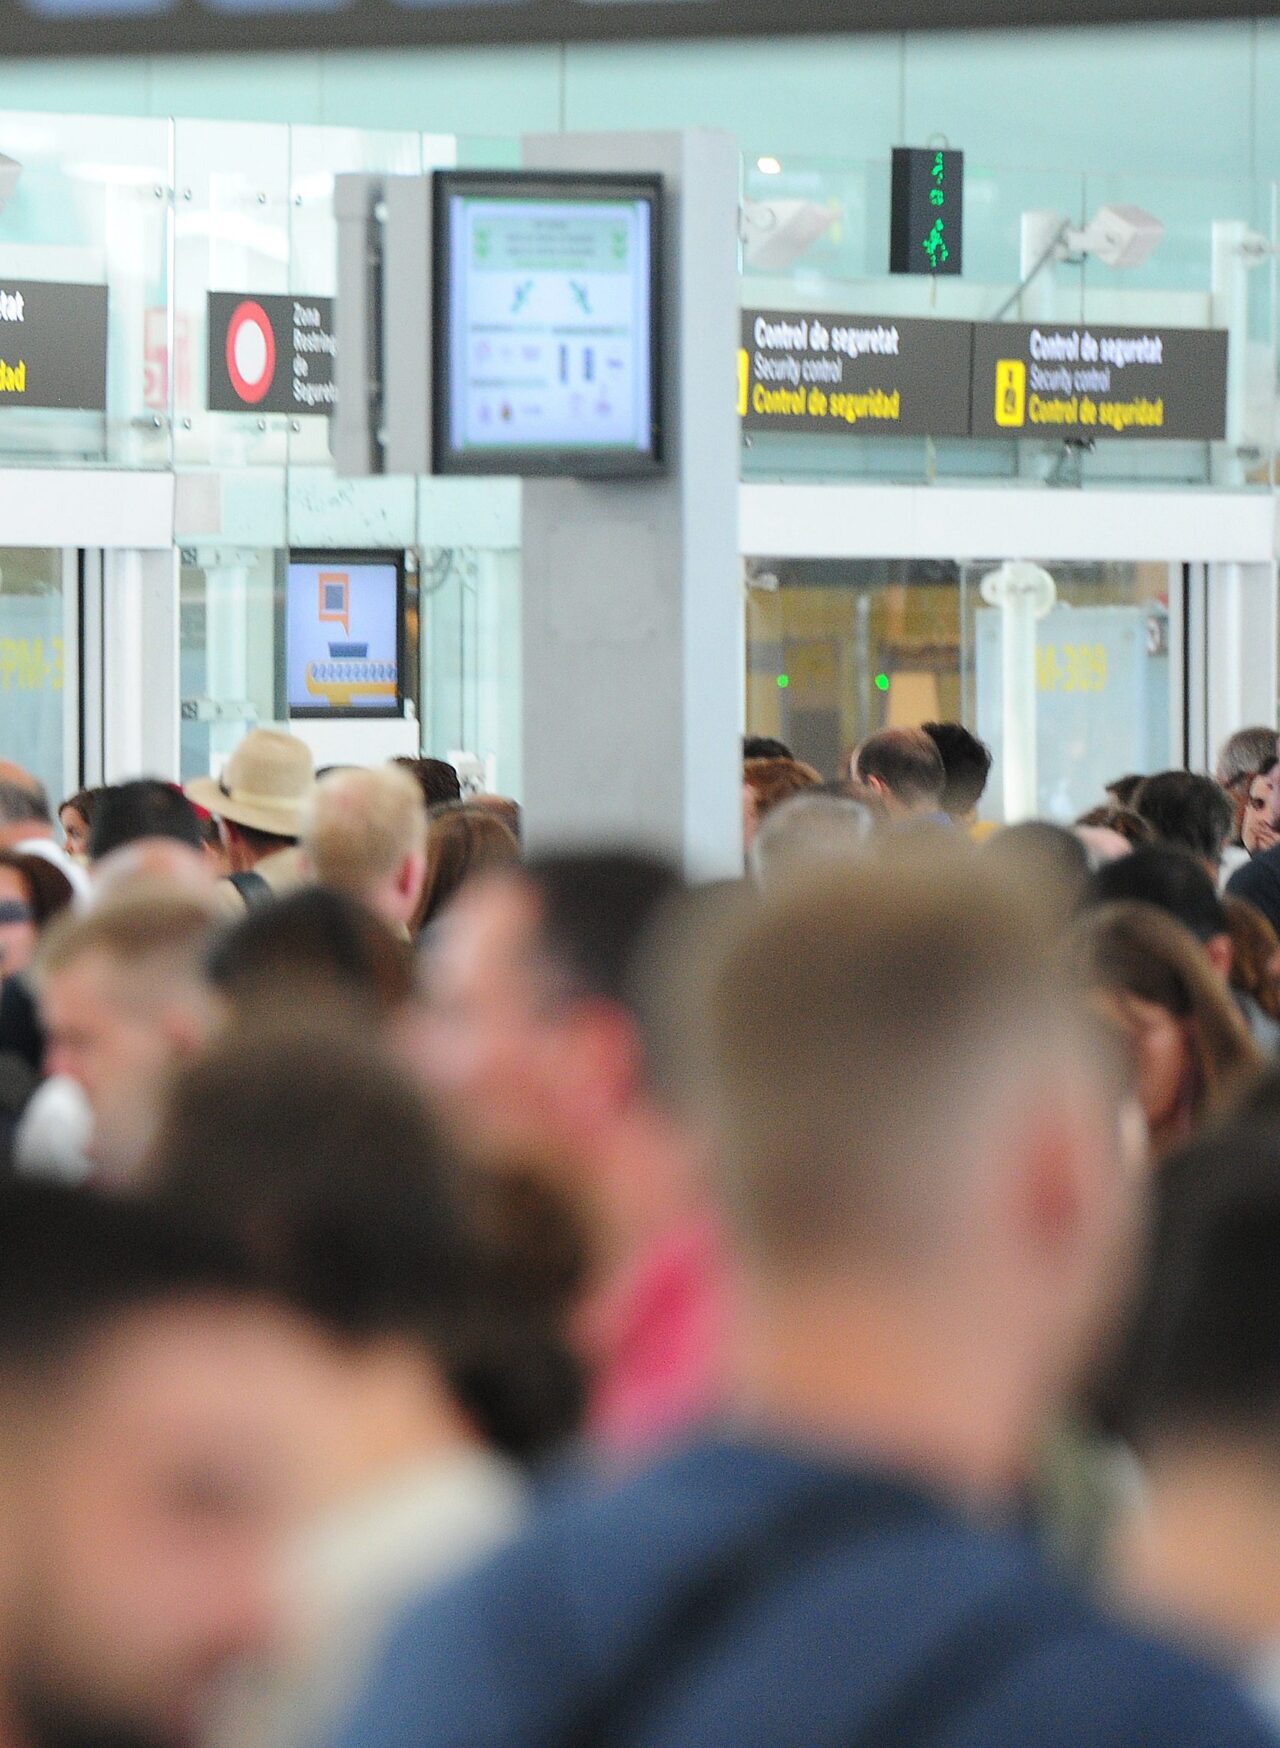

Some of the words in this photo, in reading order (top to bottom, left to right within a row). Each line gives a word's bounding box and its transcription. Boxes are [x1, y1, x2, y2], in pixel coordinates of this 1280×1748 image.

[293, 301, 321, 326] Zona
[754, 316, 808, 350] Control
[809, 319, 829, 351] de
[831, 325, 899, 359] seguretat
[1029, 328, 1080, 362] Control
[1080, 330, 1098, 362] de
[1100, 335, 1163, 369] seguretat
[292, 352, 309, 377] de
[754, 351, 800, 386] Security
[801, 355, 843, 382] control
[753, 382, 807, 415] Control
[808, 386, 828, 416] de
[830, 388, 900, 424] seguridad
[1029, 393, 1079, 424] Control
[1079, 395, 1097, 426] de
[1099, 396, 1164, 432] seguridad
[1035, 643, 1106, 692] M-309
